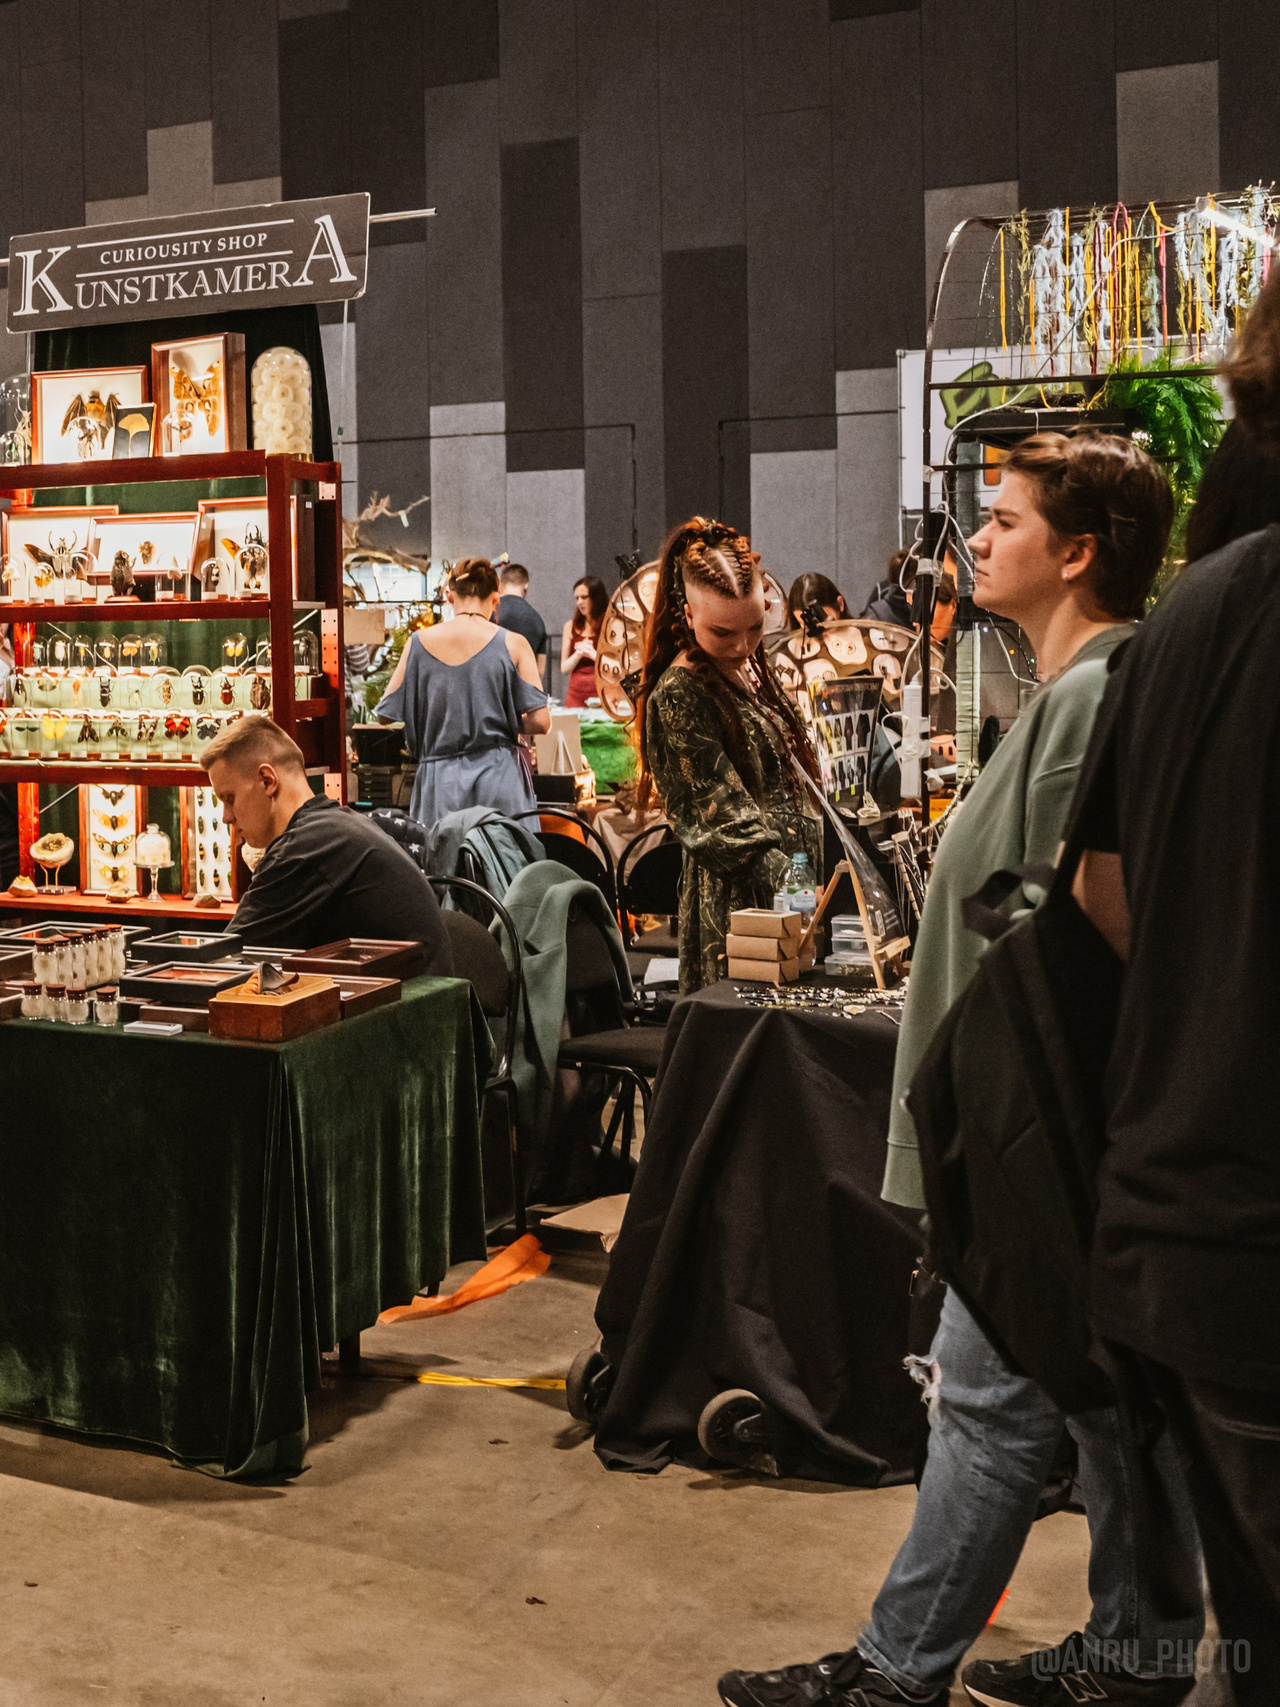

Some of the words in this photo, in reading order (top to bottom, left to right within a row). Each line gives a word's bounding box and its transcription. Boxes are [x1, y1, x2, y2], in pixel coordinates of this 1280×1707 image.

[13, 214, 357, 317] KUNSTKAMERA
[100, 239, 213, 265] CURIOUSITY
[217, 232, 268, 252] SHOP
